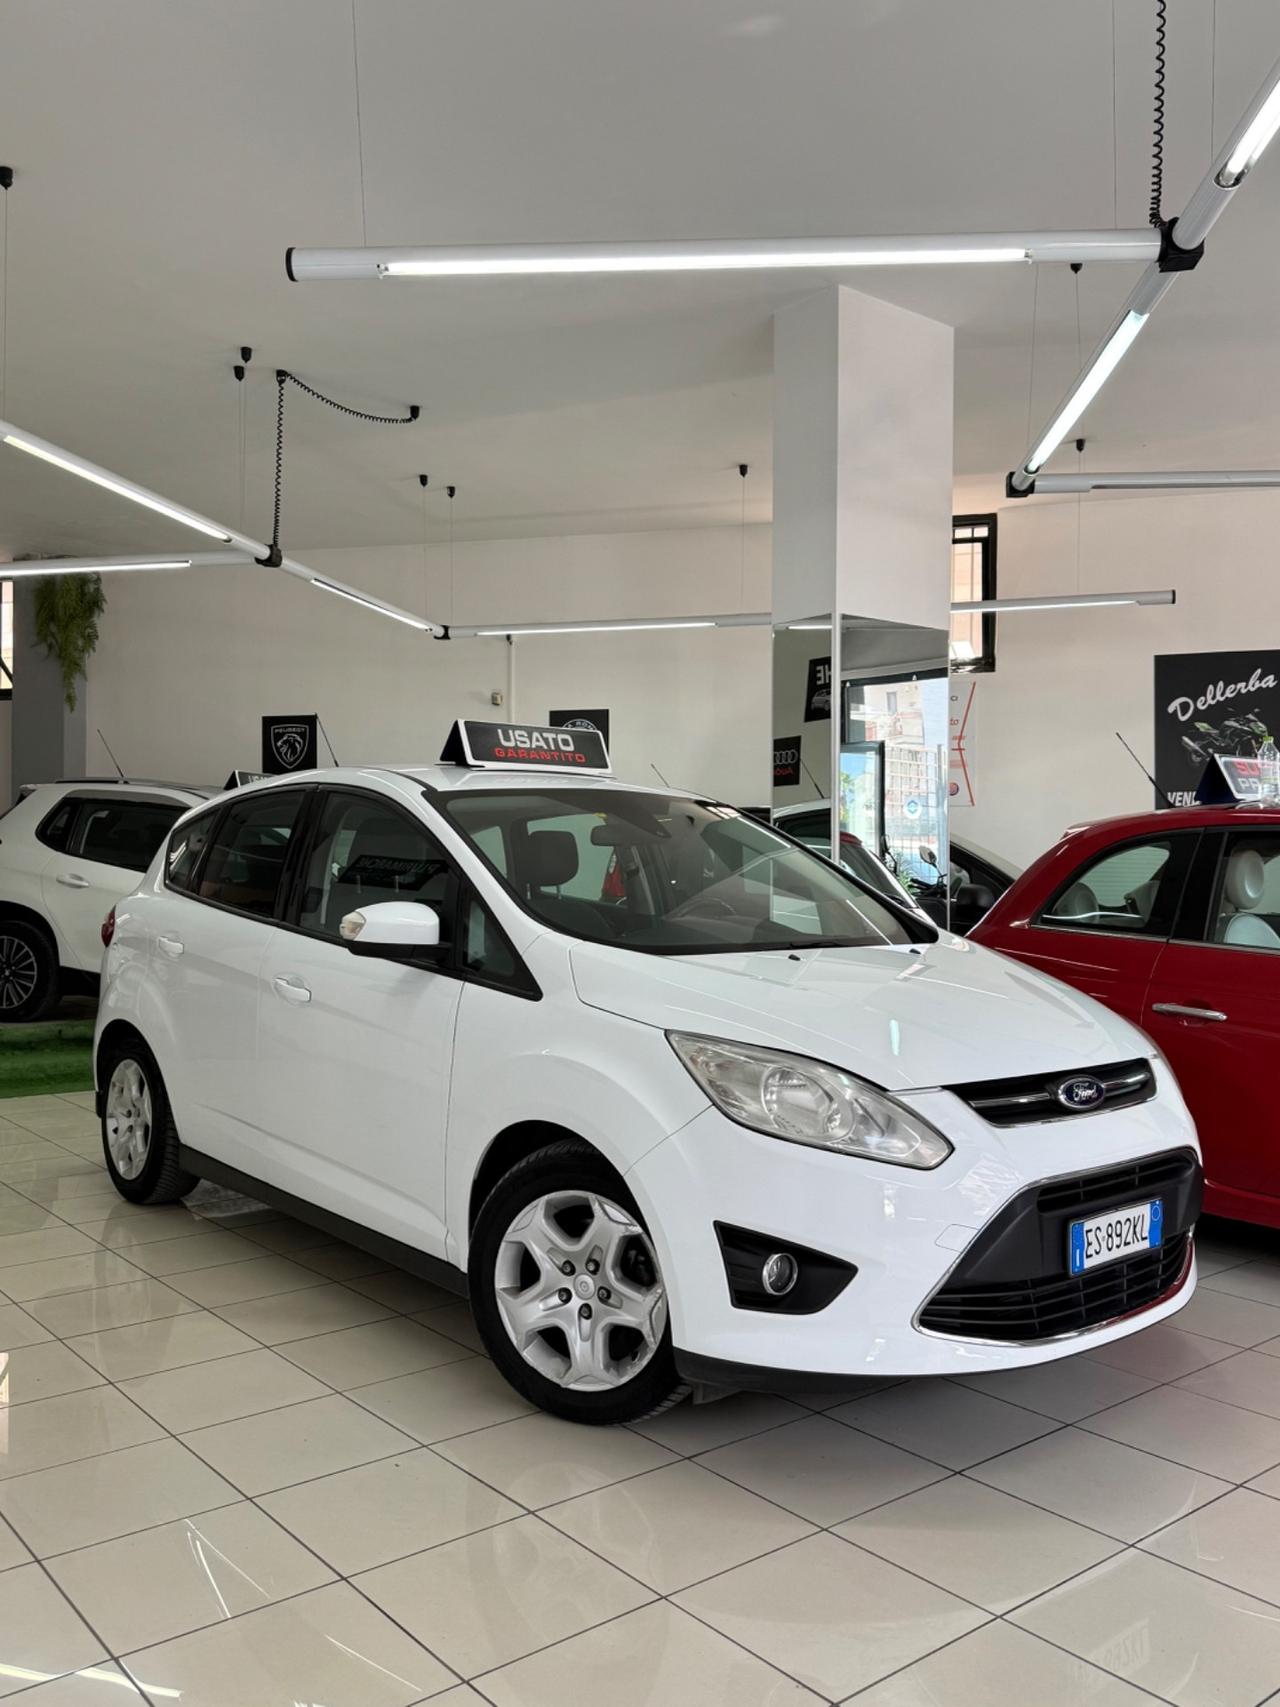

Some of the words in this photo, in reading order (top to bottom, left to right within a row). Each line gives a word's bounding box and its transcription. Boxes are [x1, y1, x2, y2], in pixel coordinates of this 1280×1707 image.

[1167, 668, 1278, 722] Dellerba
[497, 728, 575, 752] USATO
[494, 747, 587, 763] GARANTITO
[1072, 1081, 1098, 1101] Ford
